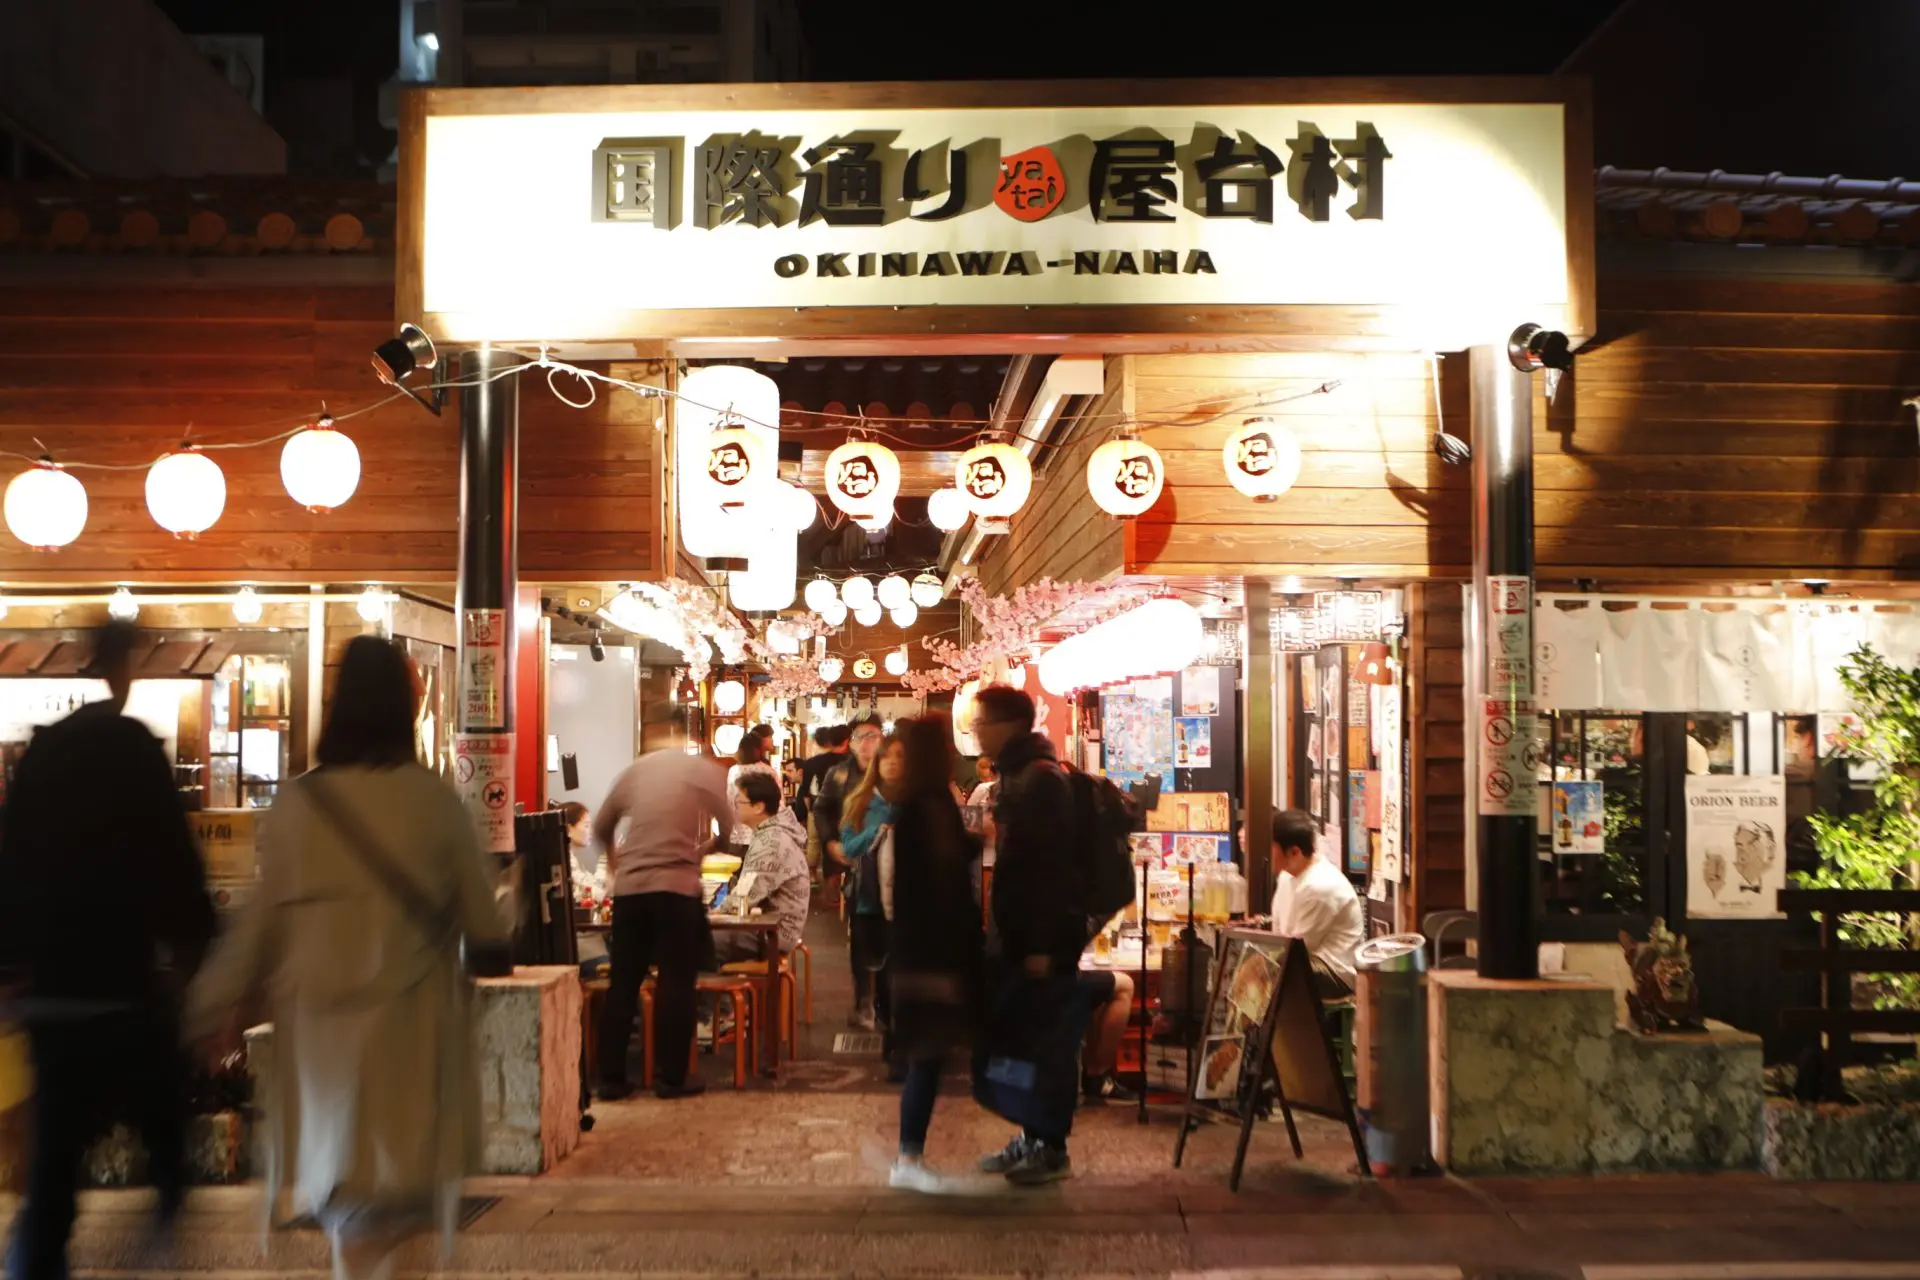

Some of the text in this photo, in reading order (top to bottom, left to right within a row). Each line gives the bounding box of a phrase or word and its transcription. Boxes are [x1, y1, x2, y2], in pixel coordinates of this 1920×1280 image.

[591, 130, 1393, 231] 国際通り 屋台村
[999, 160, 1043, 192] ya
[1011, 176, 1057, 209] tai
[774, 252, 1217, 278] OKINAWA-NAHA
[1690, 796, 1778, 807] ORION BEER
